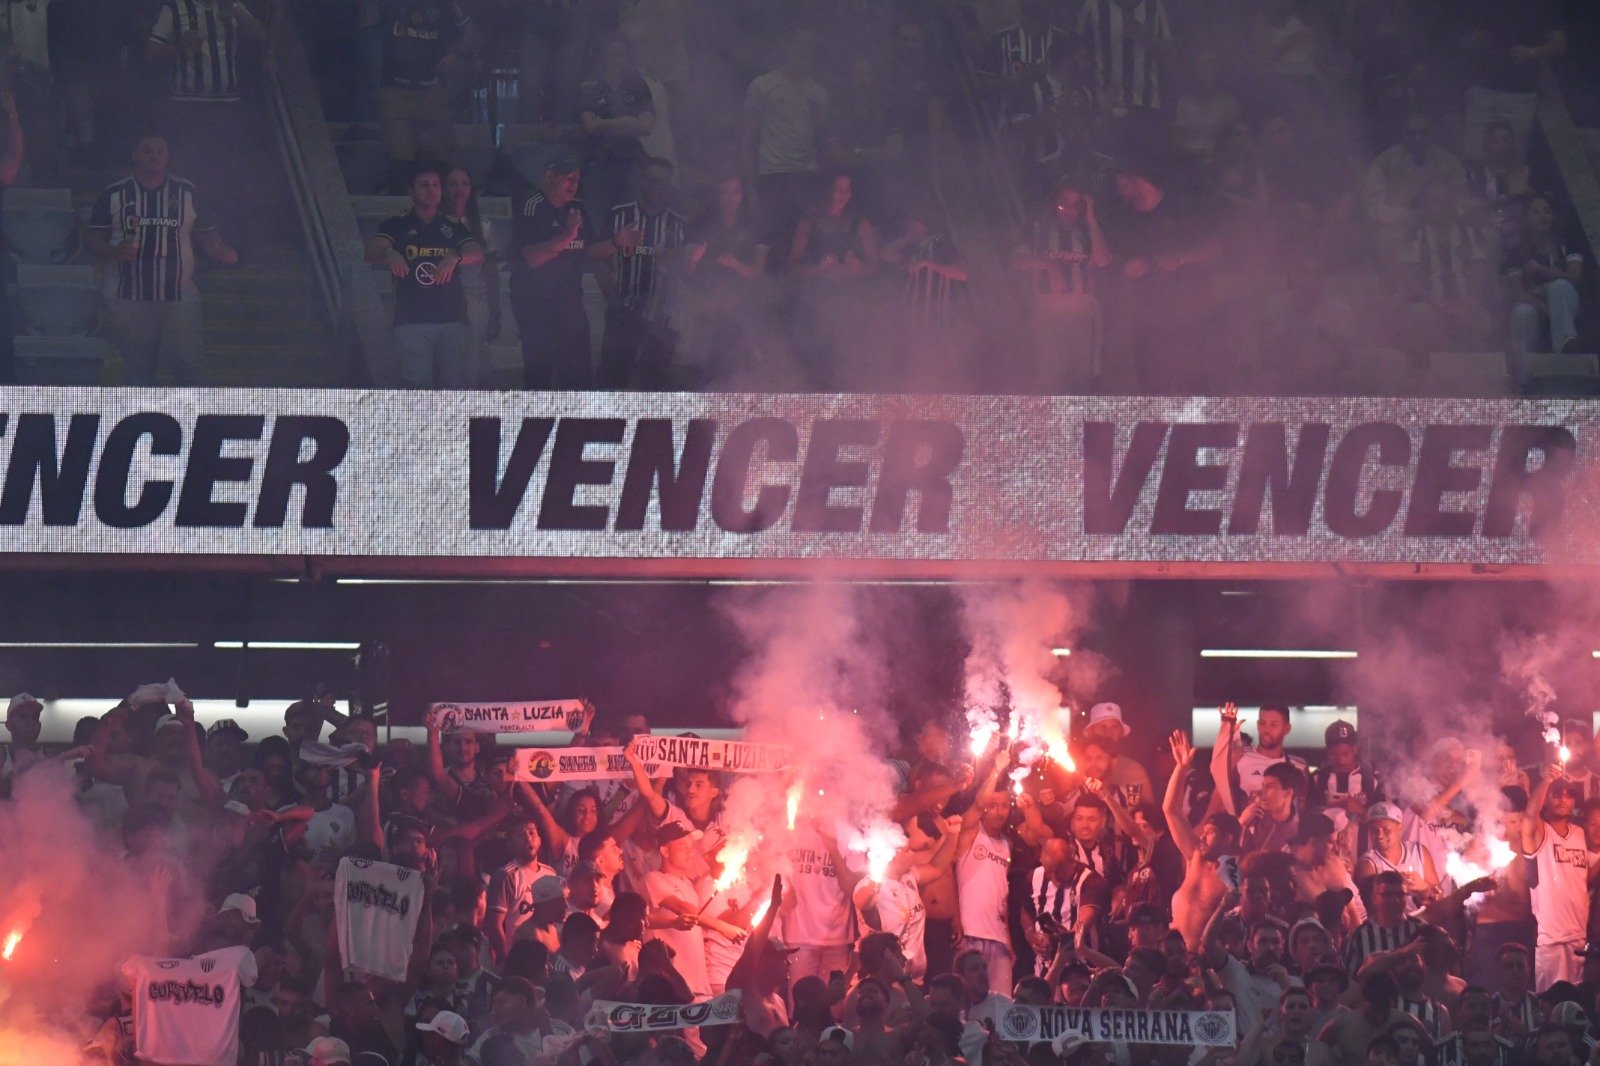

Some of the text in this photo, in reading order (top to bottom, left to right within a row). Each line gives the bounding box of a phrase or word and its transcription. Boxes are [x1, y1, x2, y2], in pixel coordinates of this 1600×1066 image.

[140, 218, 177, 227] BETANO
[0, 411, 1577, 538] NCER VENCER VENCER
[464, 707, 509, 721] SANTA
[559, 755, 597, 772] SANTA
[658, 738, 767, 770] SANTA LUZIA
[347, 880, 410, 918] CURVELO
[148, 979, 225, 1008] CURVELO
[1040, 1007, 1094, 1039] NOVA
[1100, 1009, 1194, 1041] SERRANA
